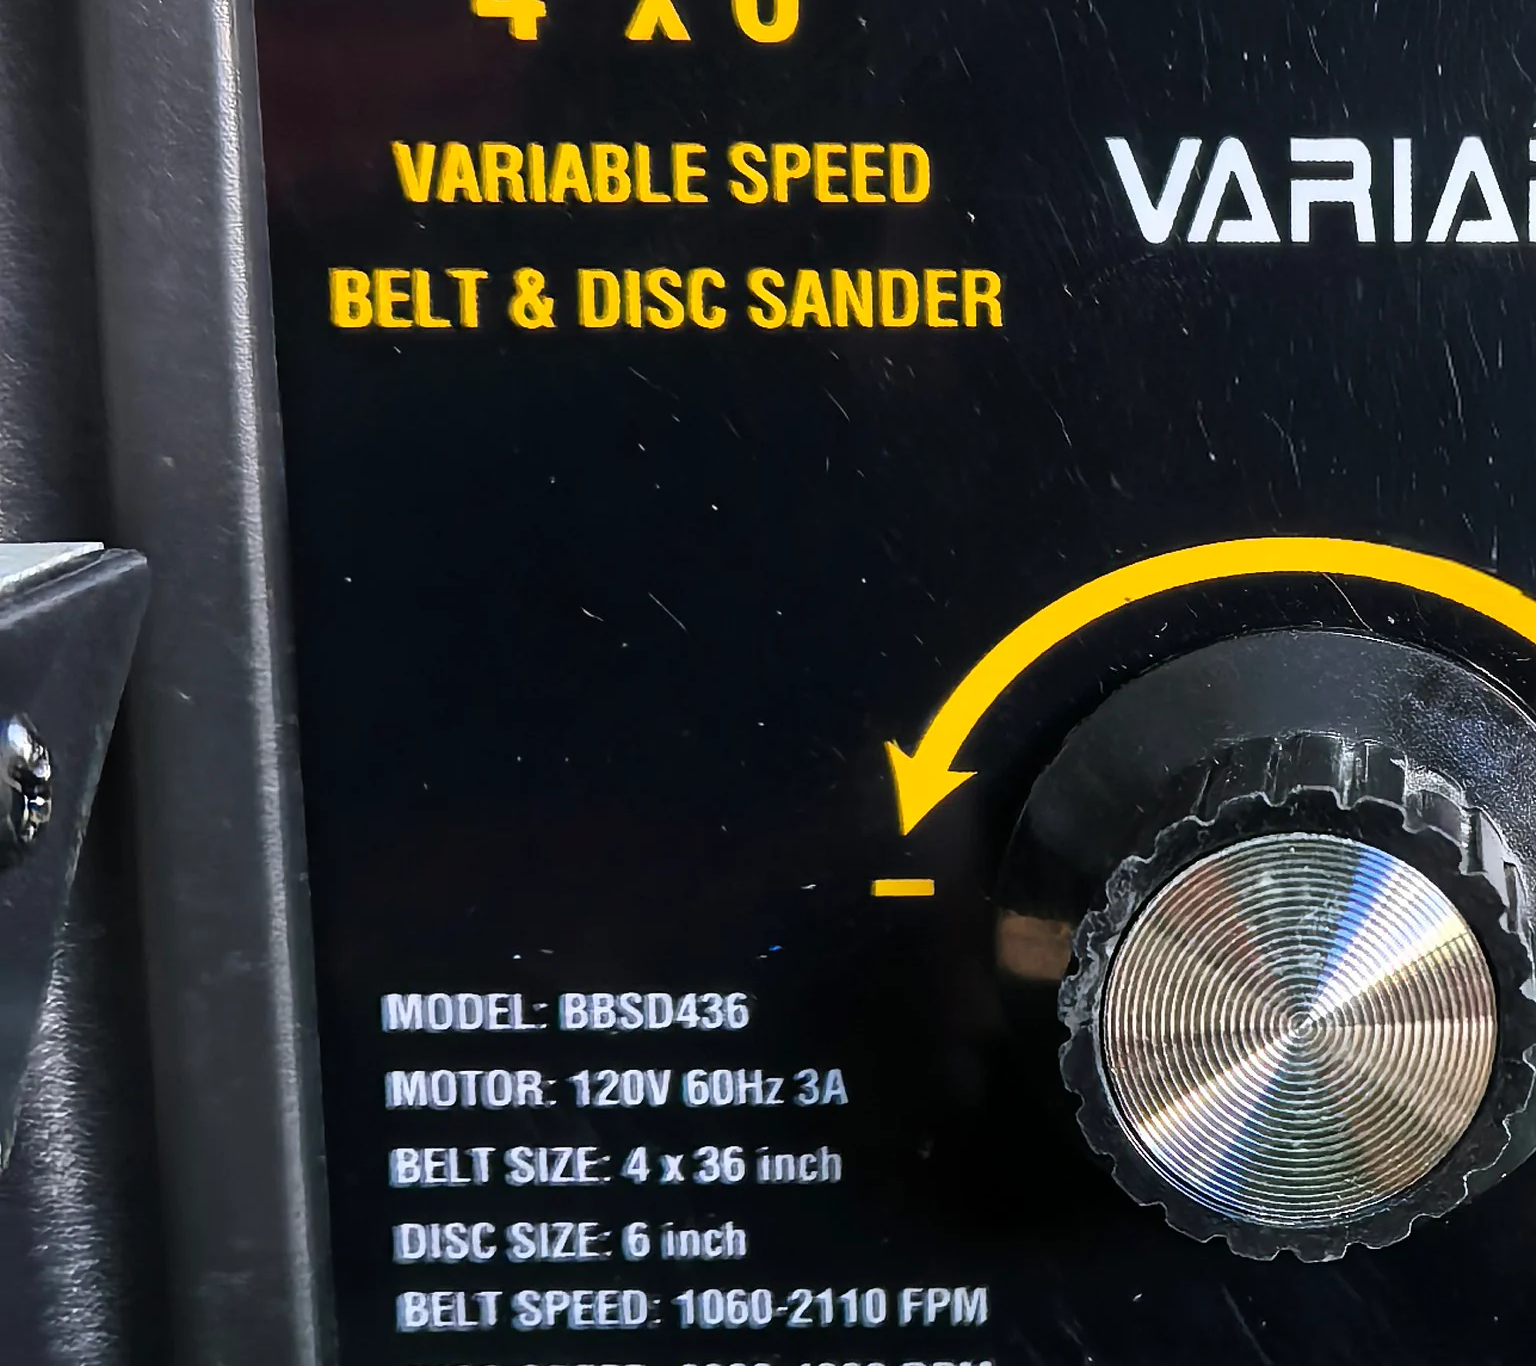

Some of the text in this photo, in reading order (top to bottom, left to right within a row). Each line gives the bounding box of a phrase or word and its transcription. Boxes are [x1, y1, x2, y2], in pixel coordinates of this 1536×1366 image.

[391, 141, 931, 204] VARIABLE SPEED
[328, 267, 1004, 329] BELT & DISC SANDER
[381, 992, 750, 1033] MODEL: BBSD436
[386, 1068, 849, 1109] MOTOR: 120V 60Hz 3A
[389, 1145, 842, 1186] BELT SIZE: 4 x 36 inch
[393, 1221, 747, 1263] DISC SIZE: 6 inch
[396, 1287, 989, 1332] BELT SPEED: 1060-2110 FPM
